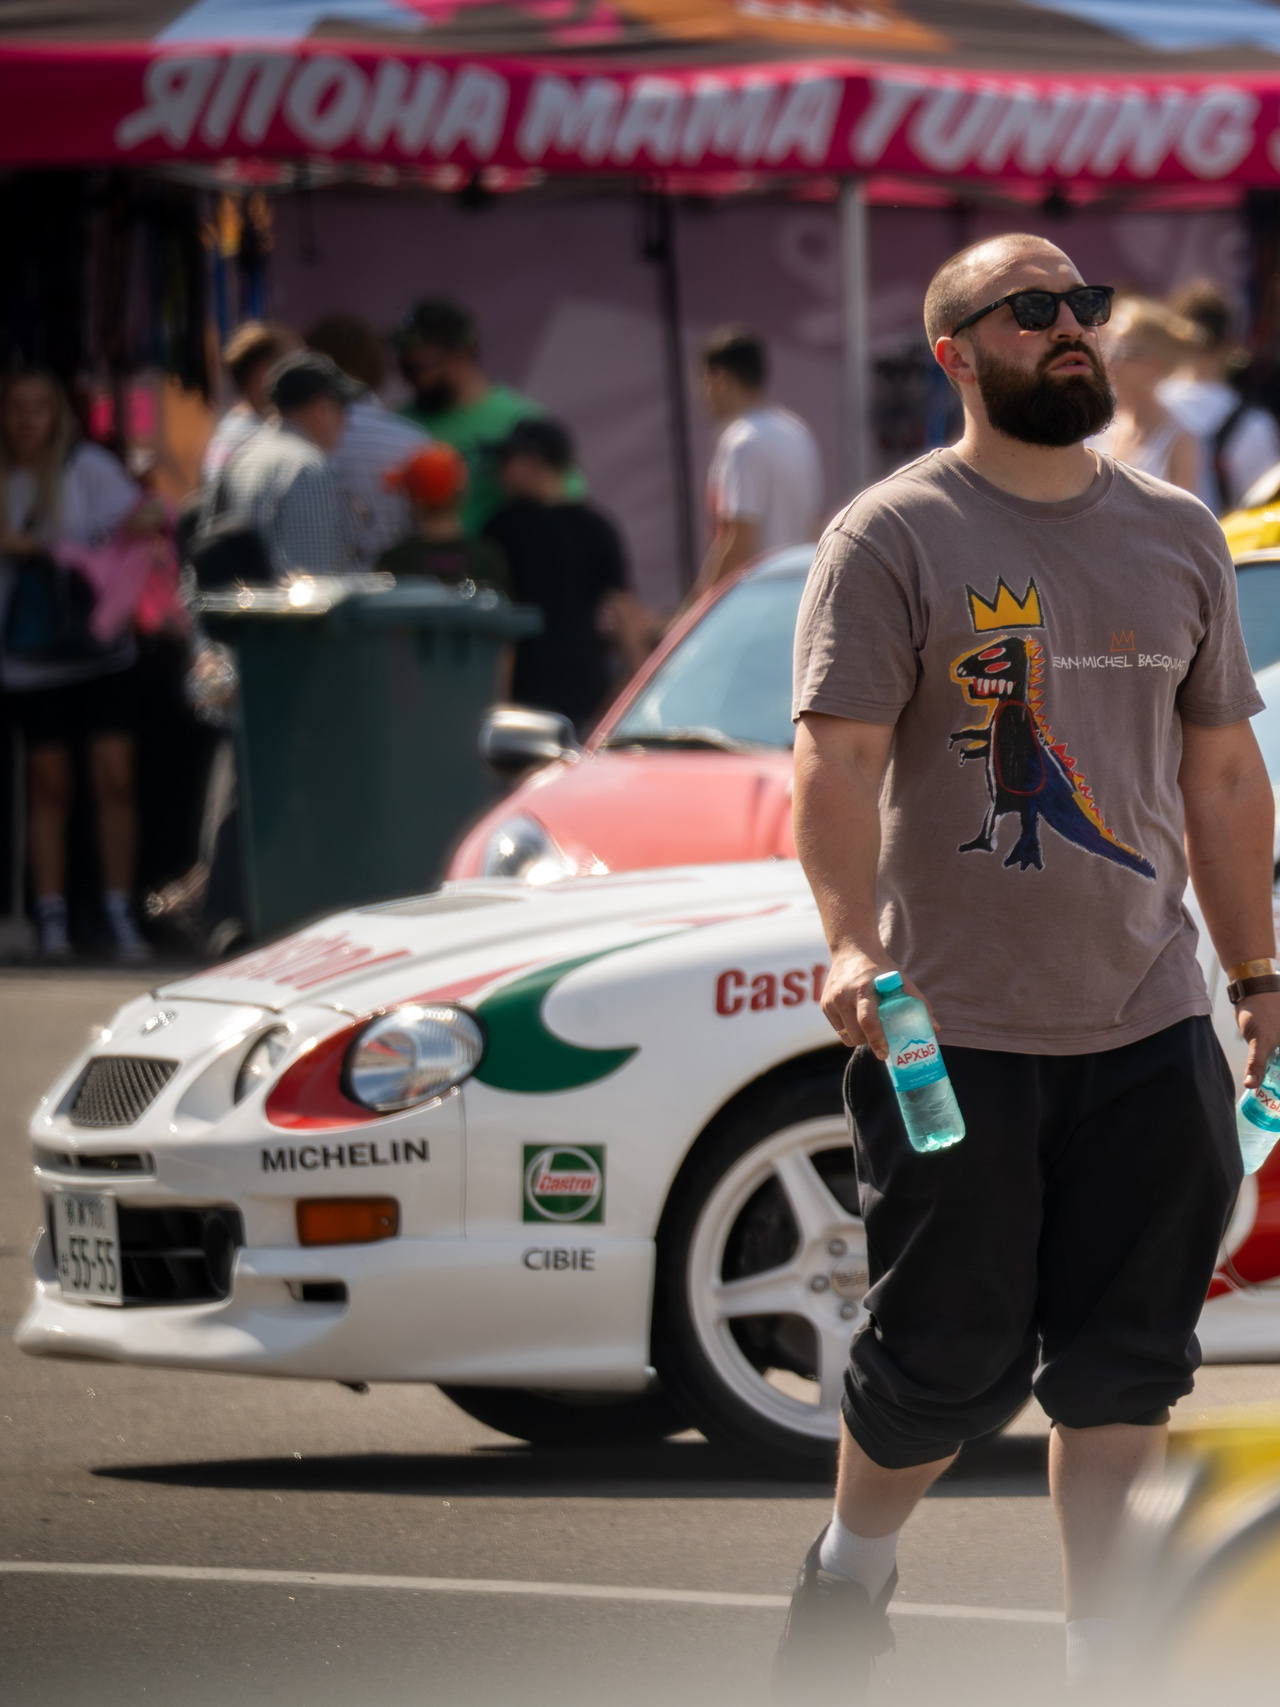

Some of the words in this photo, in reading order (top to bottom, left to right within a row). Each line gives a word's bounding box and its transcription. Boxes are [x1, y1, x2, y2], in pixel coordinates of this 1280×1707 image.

[115, 53, 510, 159] ЯПОНА
[515, 72, 845, 168] МАМА
[850, 76, 1260, 179] TUNING
[1052, 655, 1133, 670] EAN-MICHEL
[715, 963, 828, 1018] Cast
[896, 1044, 937, 1066] АРХЫЗ
[261, 1138, 430, 1173] MICHELIN
[539, 1174, 597, 1193] Castrol
[69, 1236, 117, 1292] 55-55
[523, 1248, 597, 1271] CIBIE
